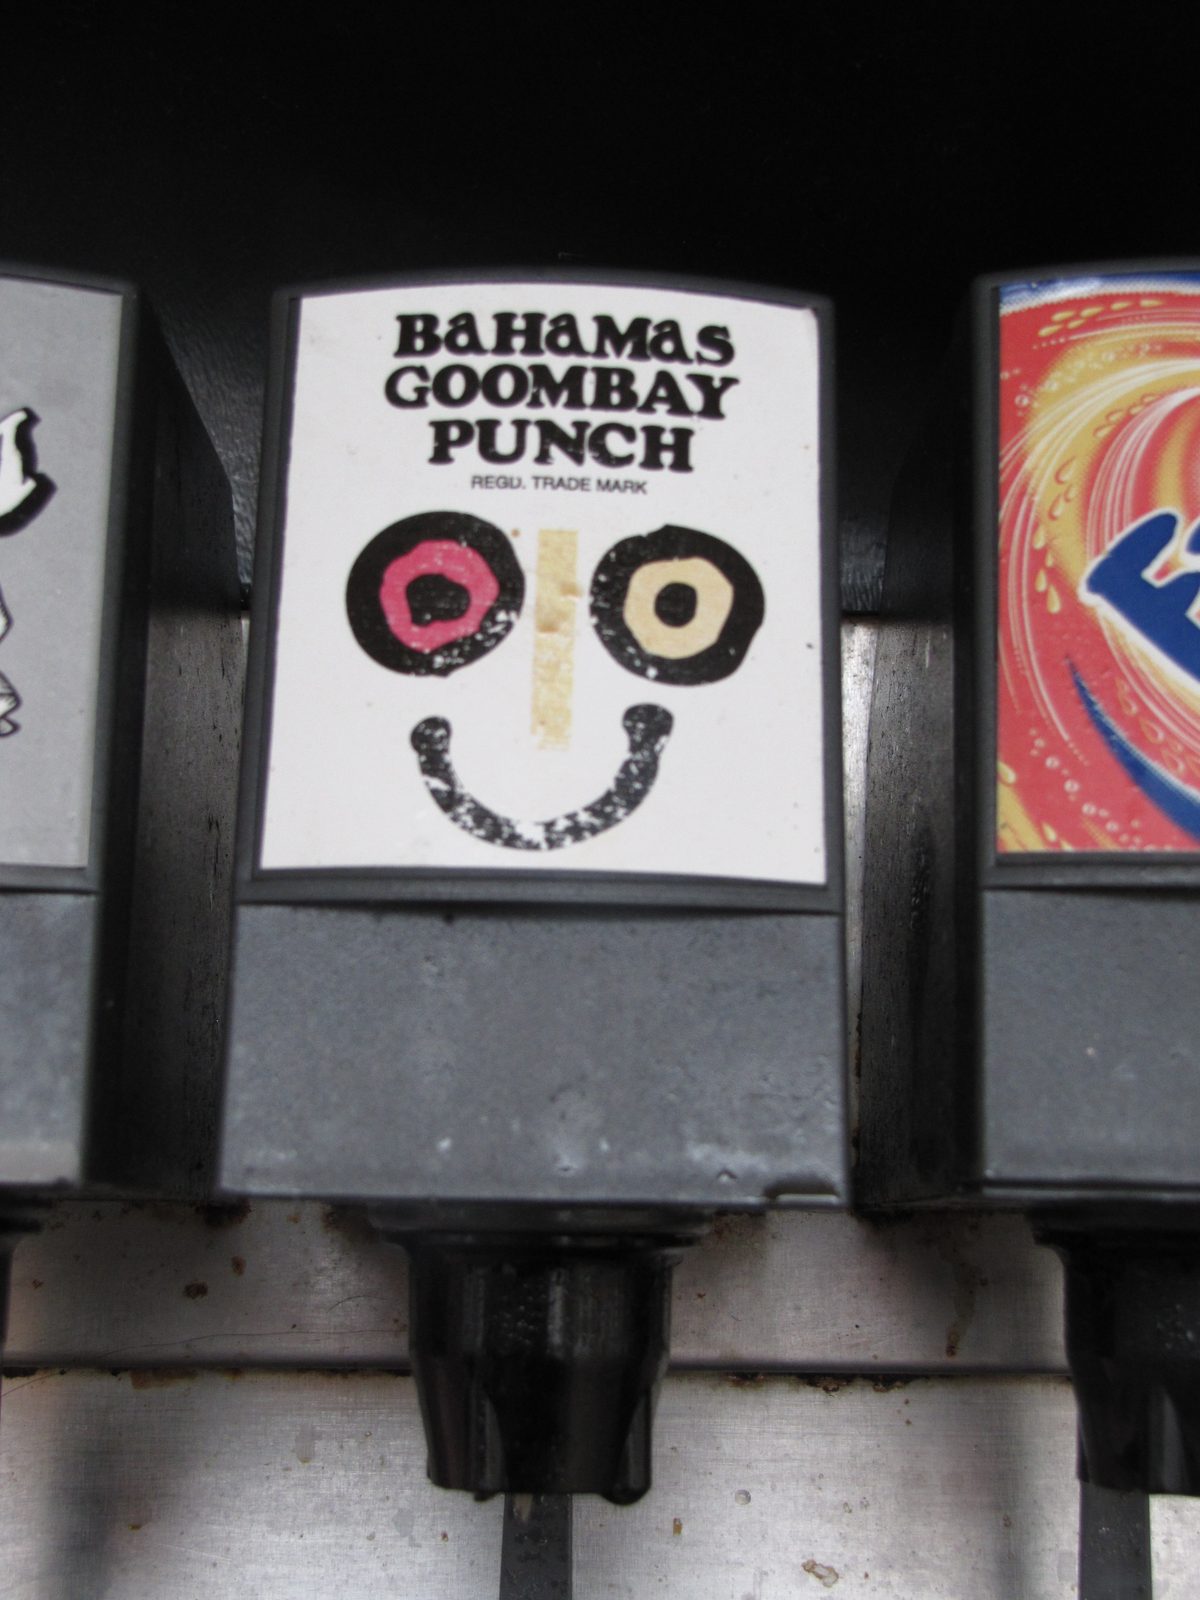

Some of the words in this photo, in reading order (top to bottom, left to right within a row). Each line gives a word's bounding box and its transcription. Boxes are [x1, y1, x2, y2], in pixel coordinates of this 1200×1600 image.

[384, 364, 740, 420] GOOMBAY
[428, 419, 695, 473] PUNCH
[532, 476, 591, 491] TRADE
[596, 479, 648, 494] MARK
